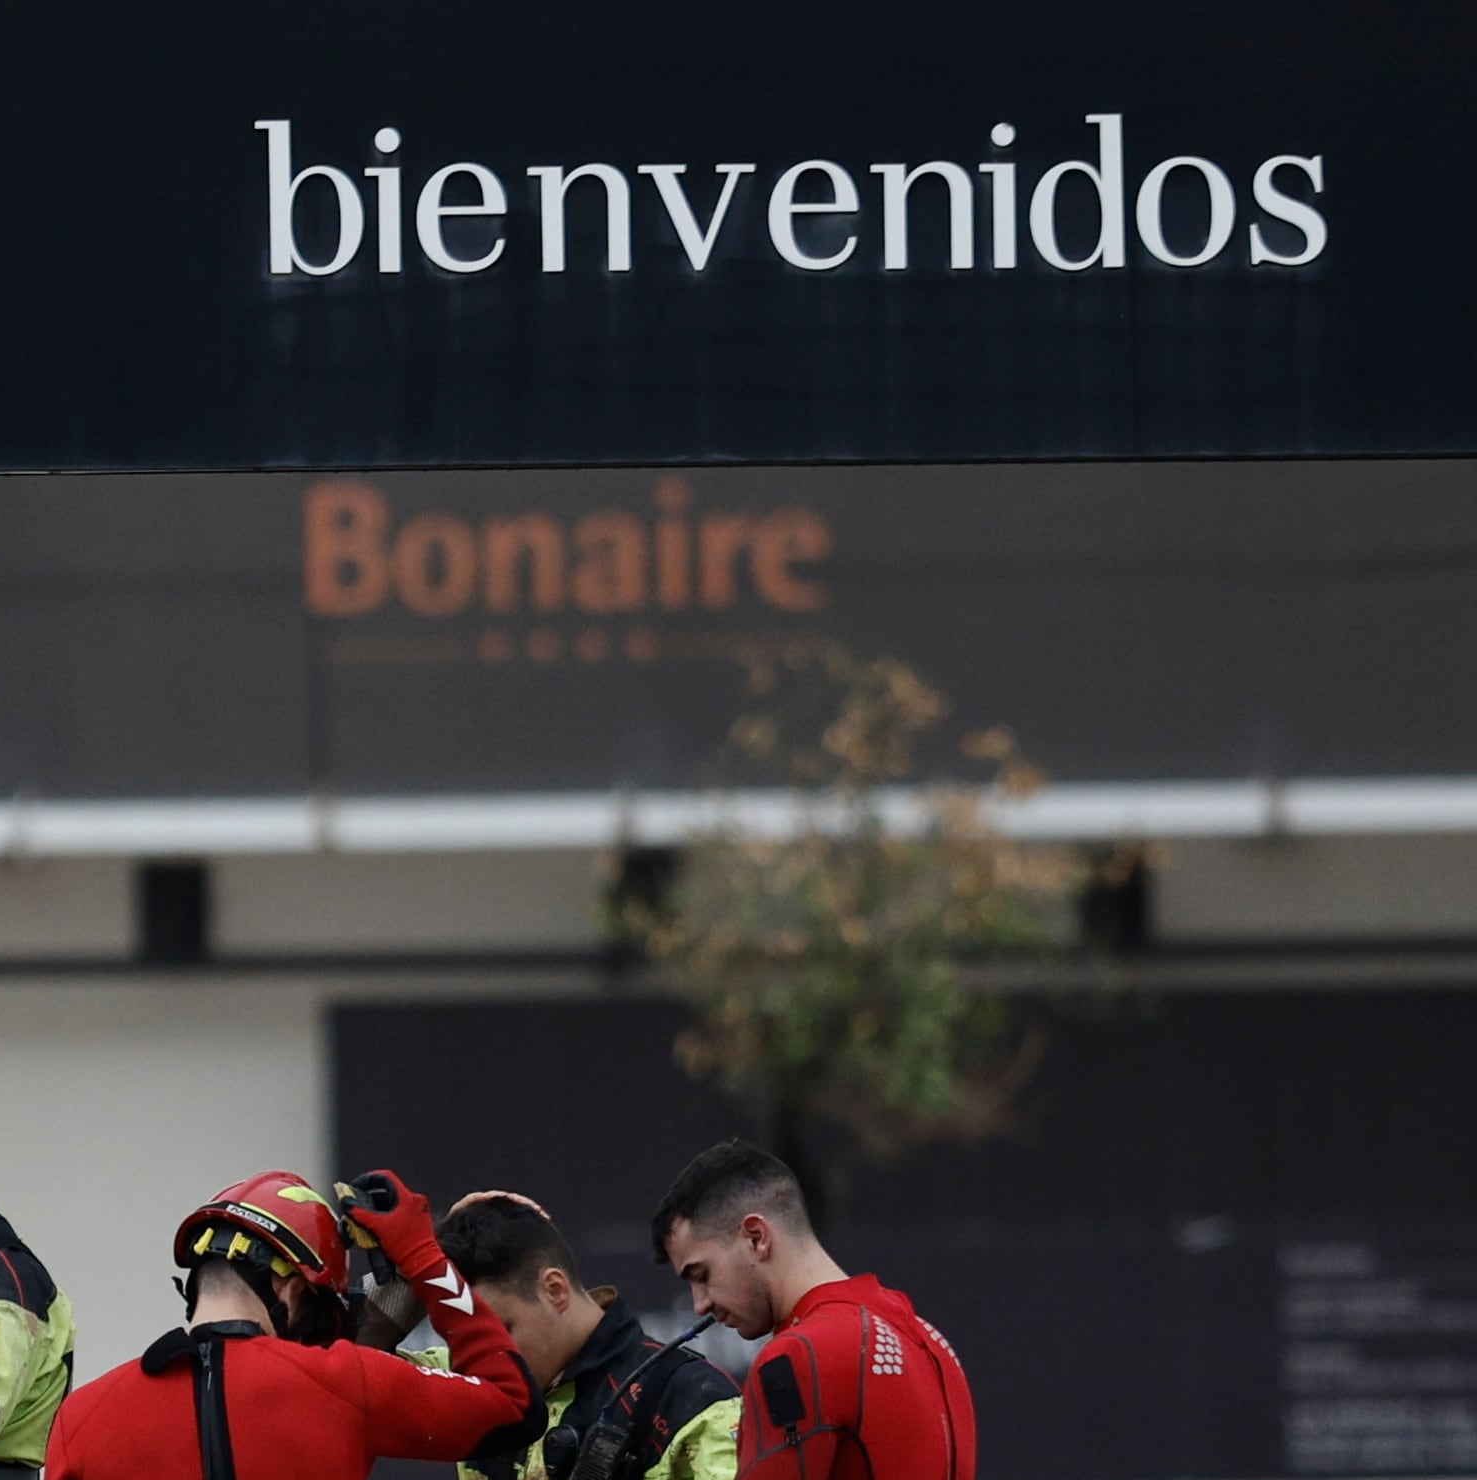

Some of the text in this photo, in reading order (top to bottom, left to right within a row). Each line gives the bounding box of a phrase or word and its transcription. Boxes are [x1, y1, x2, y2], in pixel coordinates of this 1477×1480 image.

[254, 113, 1327, 276] bienvenidos
[302, 478, 835, 617] Bonaire
[229, 1206, 273, 1230] MSA
